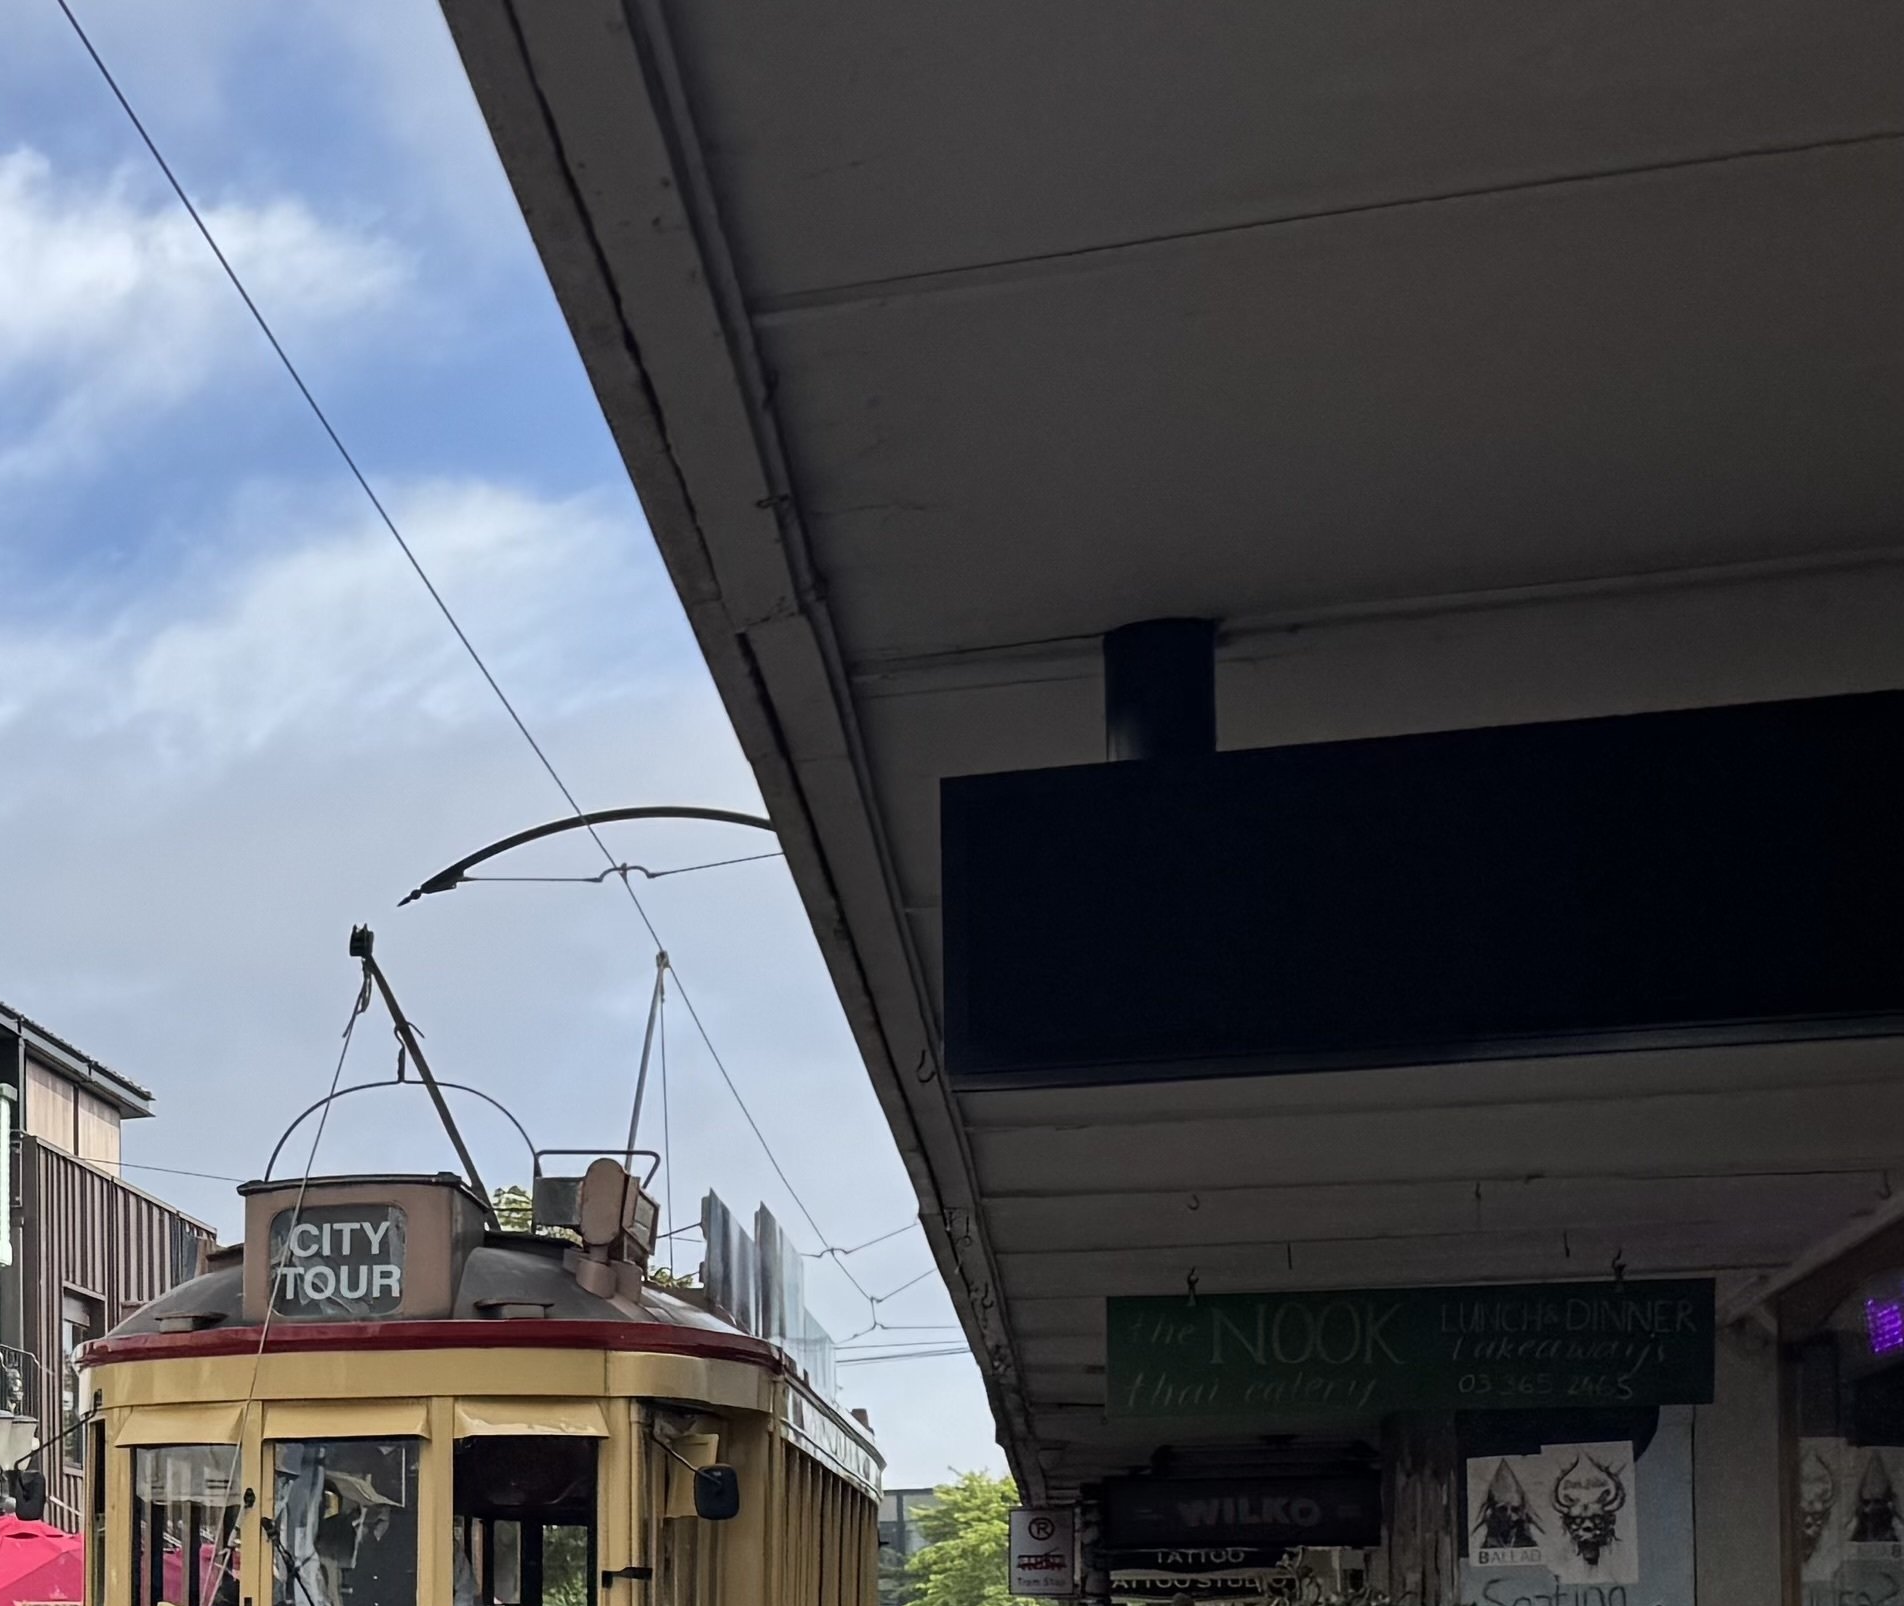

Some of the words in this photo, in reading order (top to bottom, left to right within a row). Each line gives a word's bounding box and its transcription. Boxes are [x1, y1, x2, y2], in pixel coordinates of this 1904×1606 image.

[289, 1221, 391, 1258] CITY
[278, 1263, 403, 1300] TOUR
[1208, 1301, 1407, 1366] NOOK
[1176, 1497, 1323, 1528] WILKO
[1157, 1550, 1246, 1564] TATTOO
